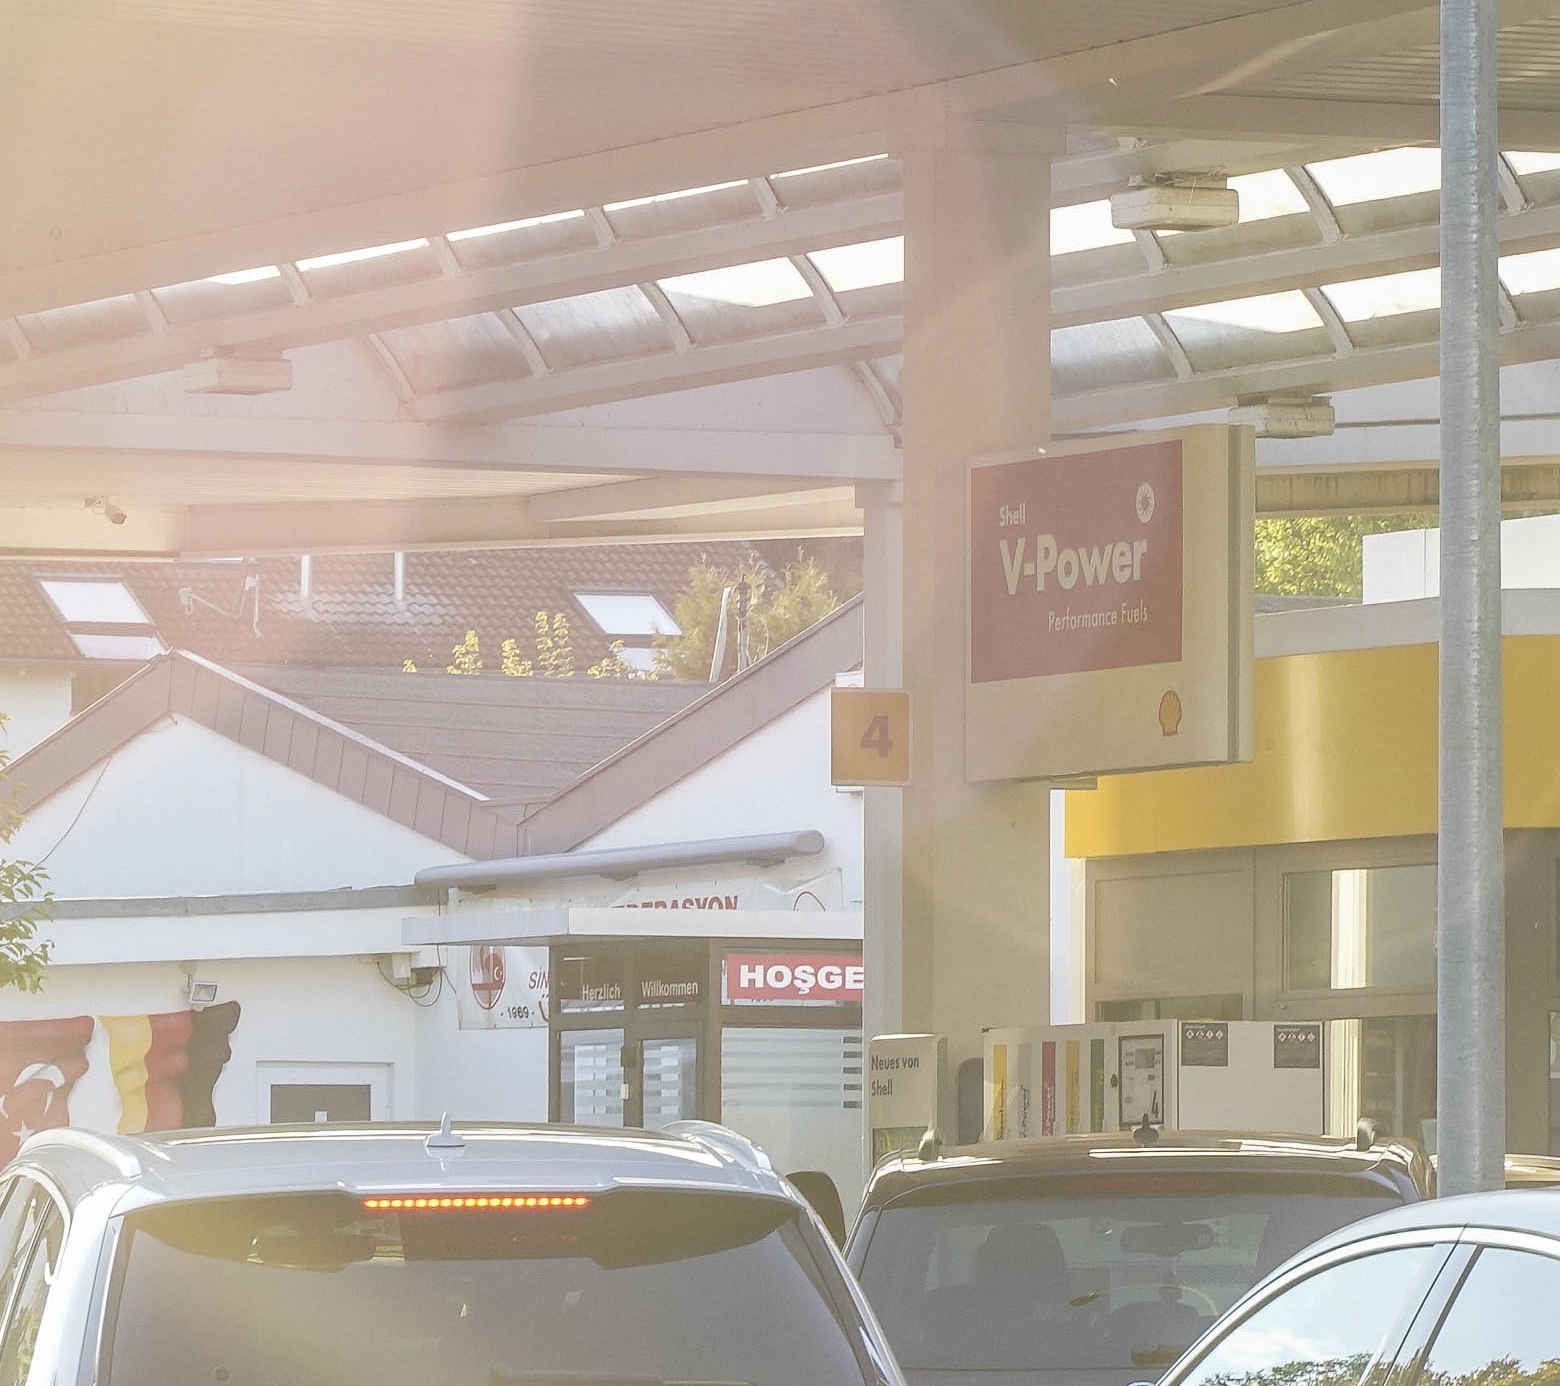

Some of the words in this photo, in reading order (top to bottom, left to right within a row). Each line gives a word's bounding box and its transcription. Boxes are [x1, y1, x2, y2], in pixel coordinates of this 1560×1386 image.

[999, 501, 1026, 527] Shell
[998, 533, 1148, 595] V-Power
[1048, 607, 1118, 633] Performance
[1121, 598, 1148, 625] Fuels
[860, 715, 893, 757] 4
[582, 982, 621, 1001] Herzlich
[641, 979, 699, 998] Willkommen
[871, 1055, 900, 1071] Neues
[902, 1056, 920, 1069] von
[871, 1079, 893, 1097] Shell
